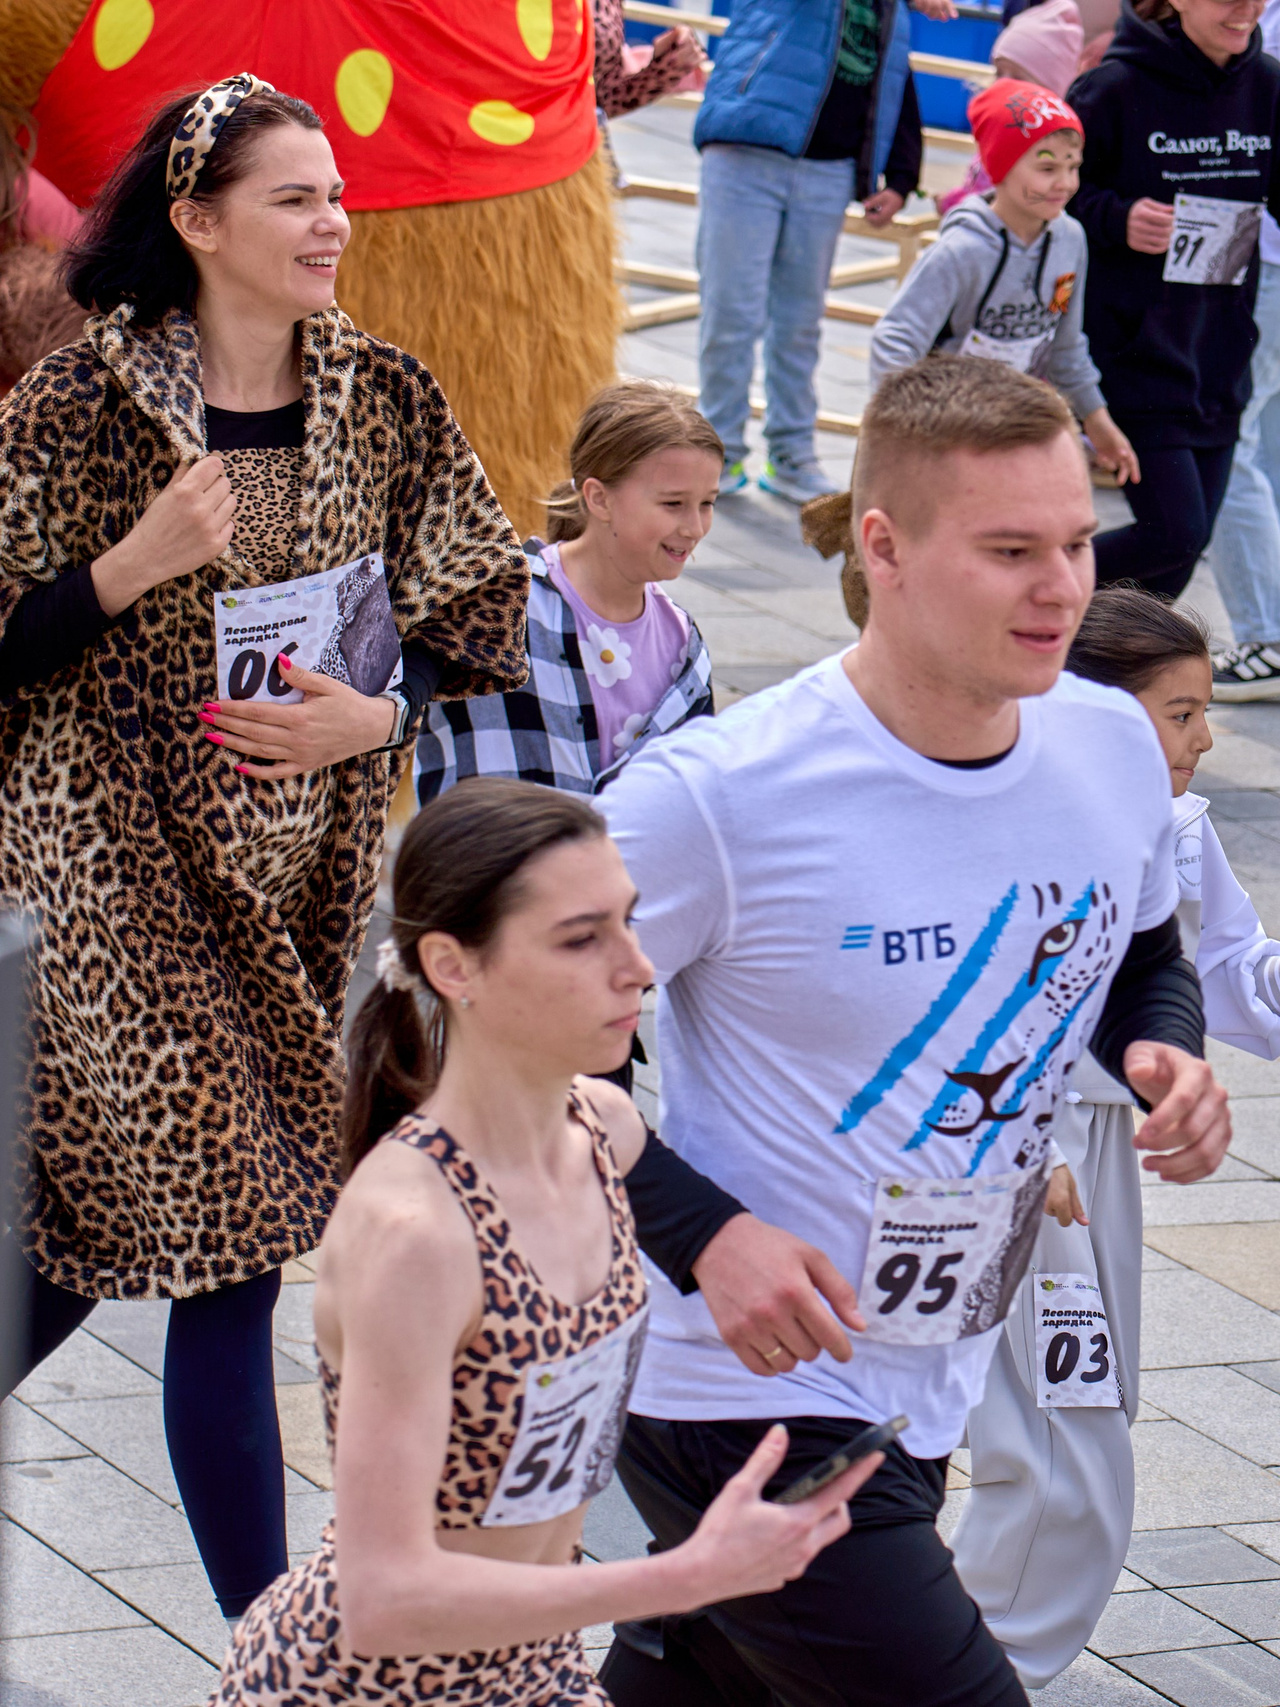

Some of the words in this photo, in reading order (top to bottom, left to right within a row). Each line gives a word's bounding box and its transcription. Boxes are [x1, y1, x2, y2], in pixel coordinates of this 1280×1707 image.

[1147, 131, 1222, 156] Салют,
[1225, 129, 1271, 157] Вера
[1173, 234, 1204, 268] 91
[223, 615, 307, 636] Леопардовая
[224, 632, 280, 646] зарядка
[227, 641, 299, 700] 06
[882, 922, 957, 966] ВТБ
[875, 1251, 965, 1315] 95
[1042, 1319, 1093, 1329] зарядка
[1045, 1332, 1110, 1385] 03
[503, 1416, 587, 1499] 52
